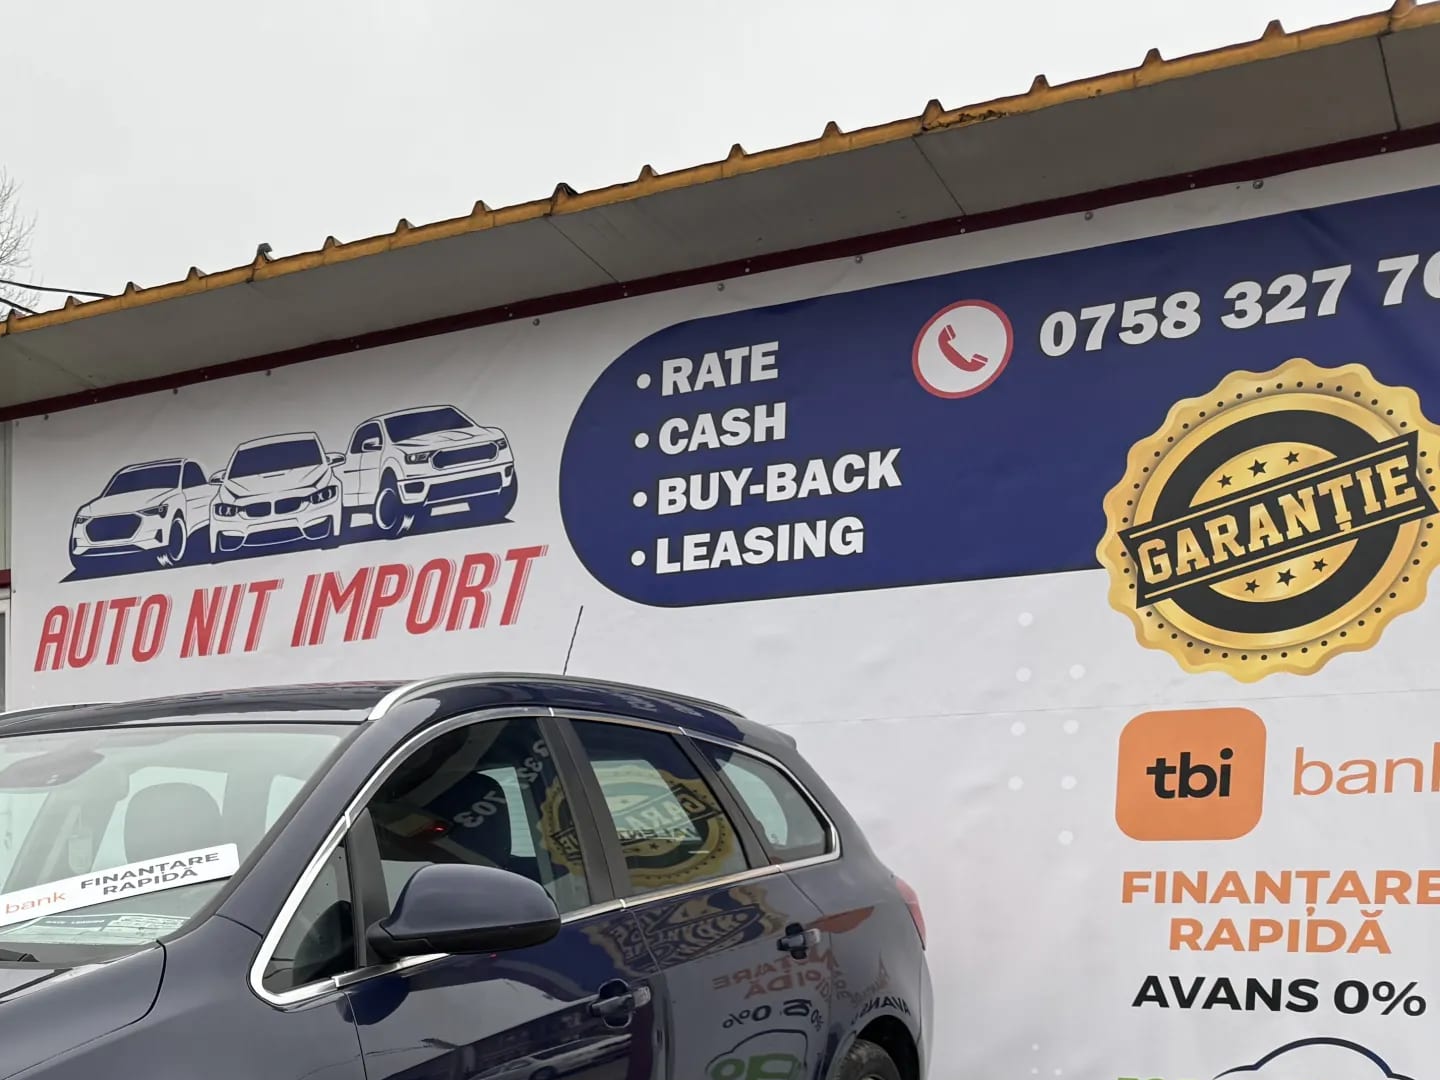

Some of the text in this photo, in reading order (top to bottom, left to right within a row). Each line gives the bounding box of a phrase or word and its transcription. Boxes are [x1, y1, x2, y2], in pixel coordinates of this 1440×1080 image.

[1040, 250, 1440, 357] 0758 327 7
[662, 341, 779, 396] RATE
[659, 402, 786, 455] CASH
[658, 448, 902, 515] BUY-BACK
[656, 516, 864, 574] LEASING
[1137, 455, 1417, 584] GARANȚIE
[34, 544, 550, 672] AUTO NIT IMPORT
[1146, 741, 1440, 799] tbi ban
[5, 891, 67, 915] bank
[1169, 909, 1391, 955] RAPIDĂ
[1132, 975, 1427, 1017] AVANS 0%
